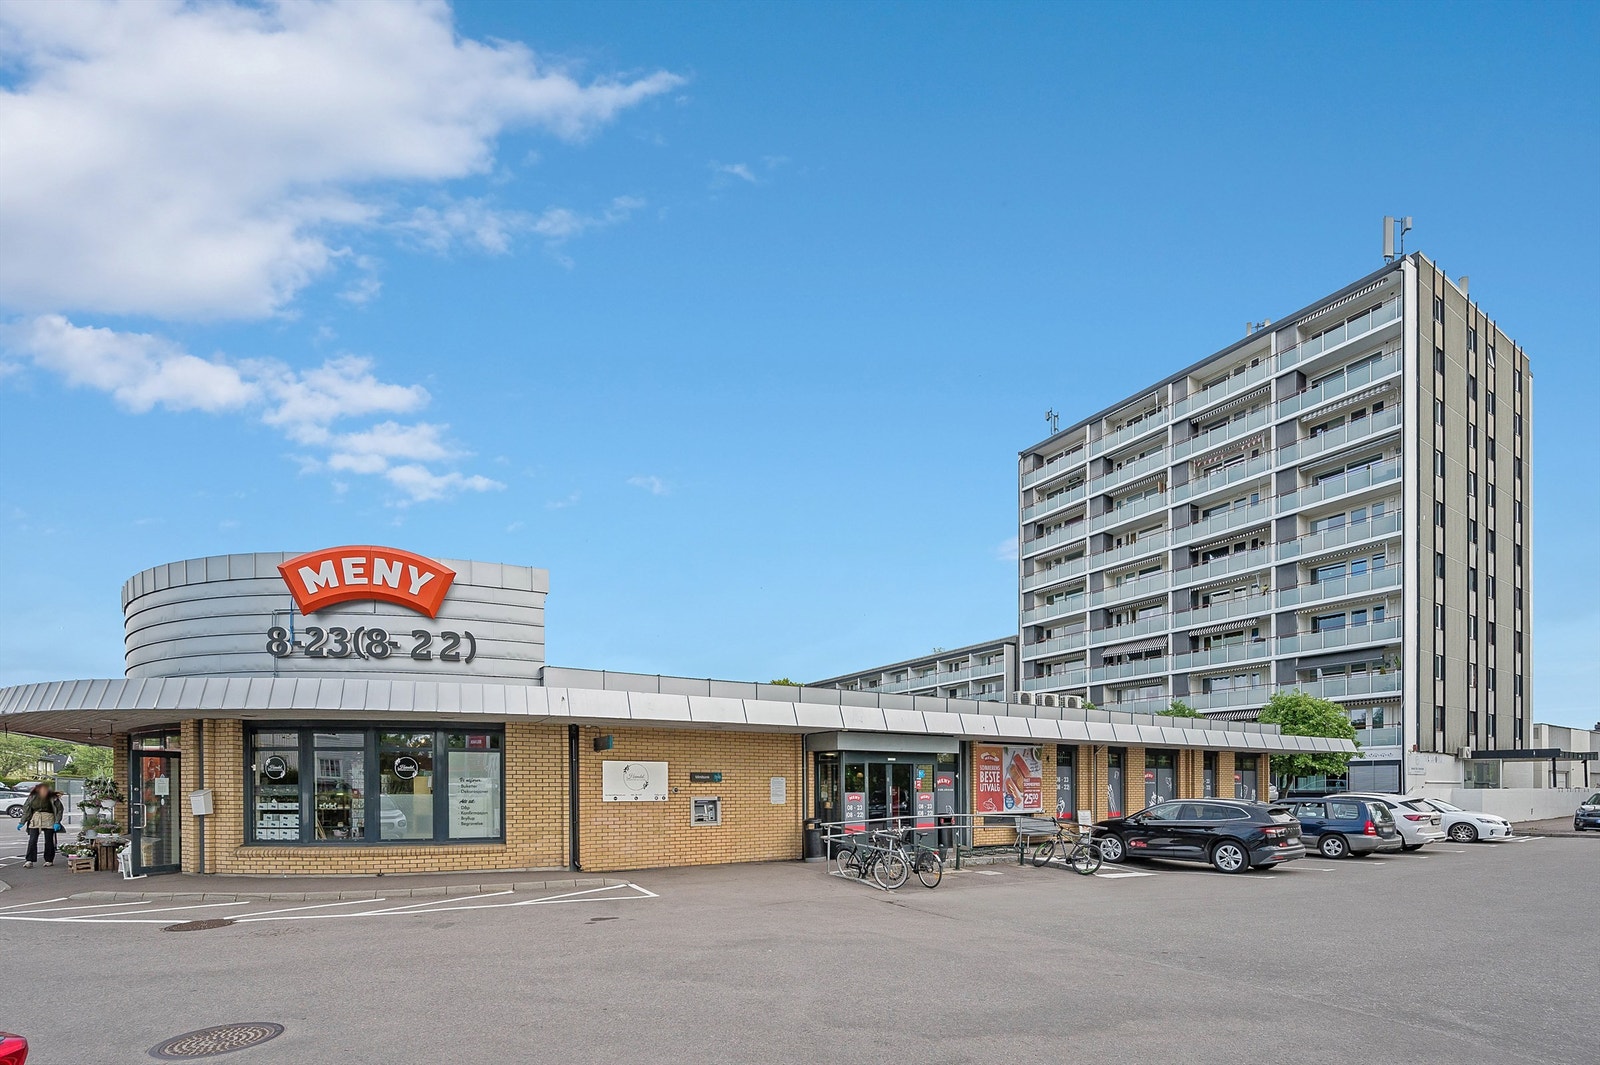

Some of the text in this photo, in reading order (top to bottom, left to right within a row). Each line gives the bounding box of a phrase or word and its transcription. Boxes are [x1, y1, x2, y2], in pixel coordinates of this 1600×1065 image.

[298, 556, 435, 595] MENY
[979, 771, 1000, 783] BESTE
[979, 783, 1001, 792] UTVALG
